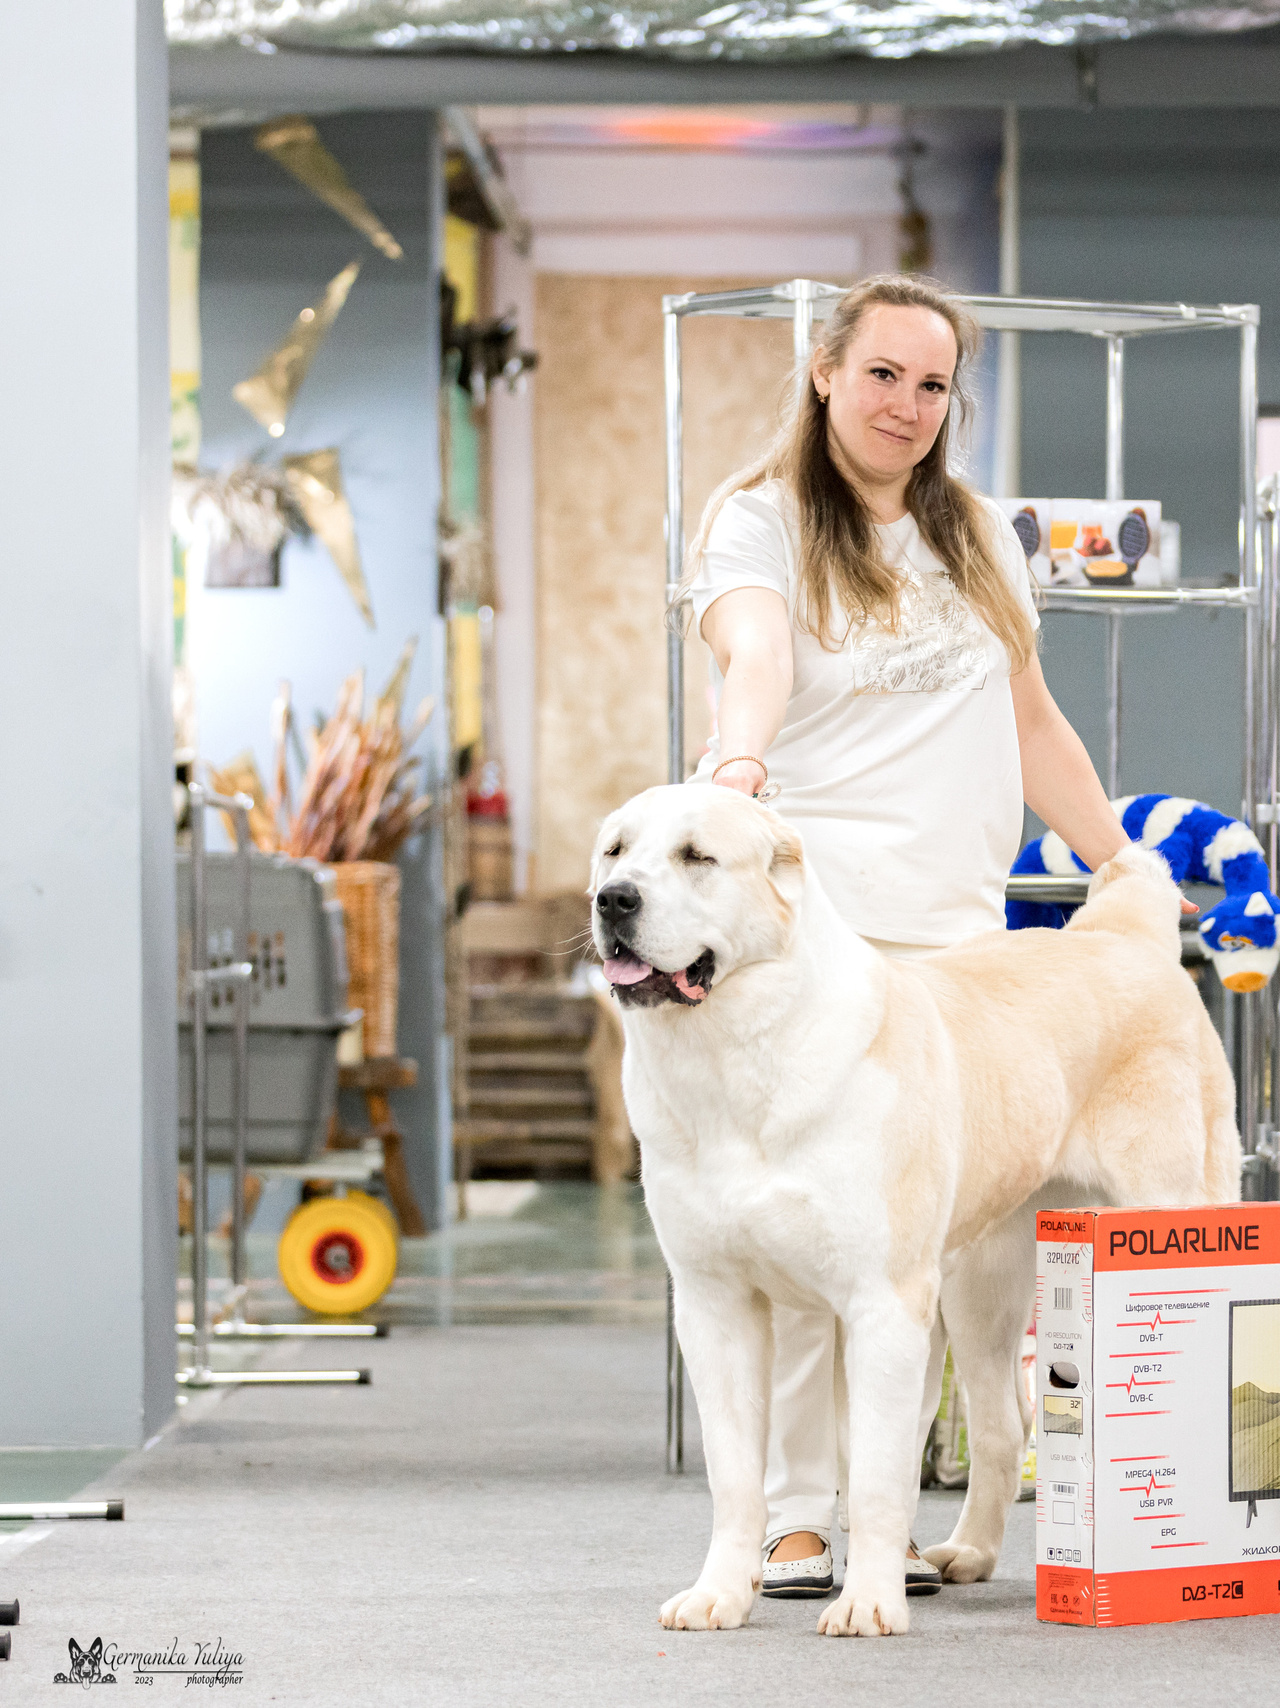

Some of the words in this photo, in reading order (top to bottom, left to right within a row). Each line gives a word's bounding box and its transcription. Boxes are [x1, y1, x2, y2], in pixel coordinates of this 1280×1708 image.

[1040, 1220, 1086, 1233] POLARLINE
[1109, 1224, 1260, 1257] POLARLINE
[1125, 1303, 1163, 1313] Цифровое
[1164, 1301, 1210, 1311] телевидение
[1139, 1333, 1164, 1343] DVB-T
[1133, 1364, 1162, 1374] DVB-T2
[1129, 1394, 1154, 1403] DVB-C
[1125, 1470, 1152, 1479] MPEG4
[1155, 1467, 1176, 1477] H.264
[1139, 1499, 1155, 1508] USB
[1157, 1498, 1173, 1507] PVR
[1161, 1528, 1177, 1537] EPG
